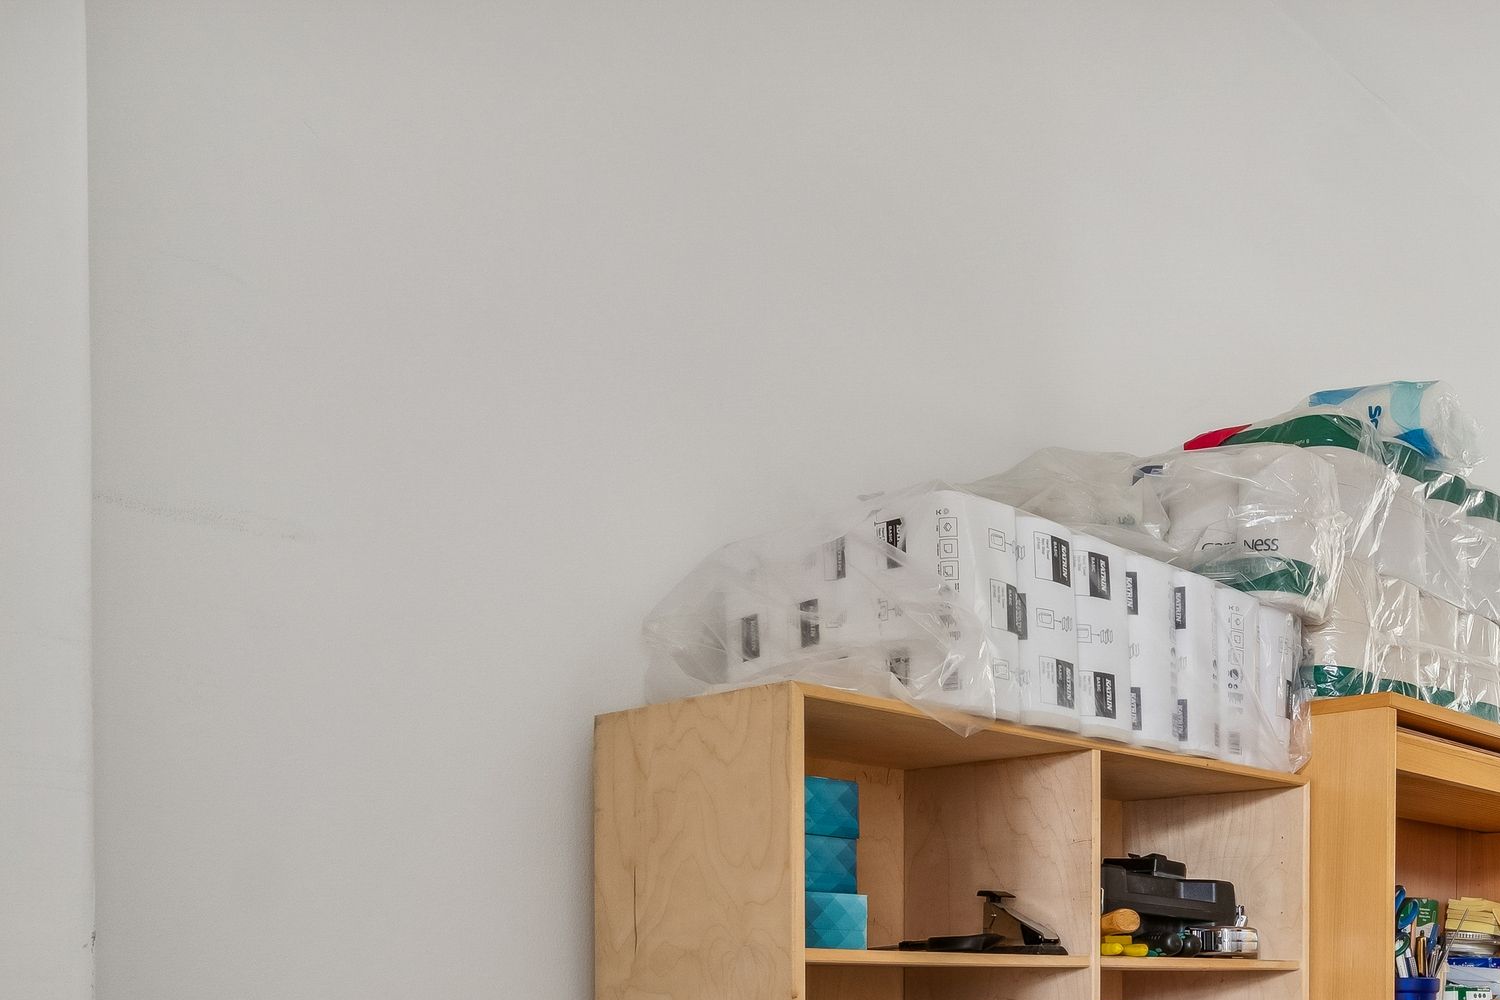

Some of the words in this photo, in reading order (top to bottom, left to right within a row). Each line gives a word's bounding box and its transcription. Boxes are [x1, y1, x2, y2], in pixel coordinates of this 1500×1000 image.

[1060, 544, 1068, 580] KATRIN
[1099, 559, 1107, 594] KATRIN
[1065, 667, 1073, 701] KATRIN
[1105, 678, 1113, 713] KATRIN
